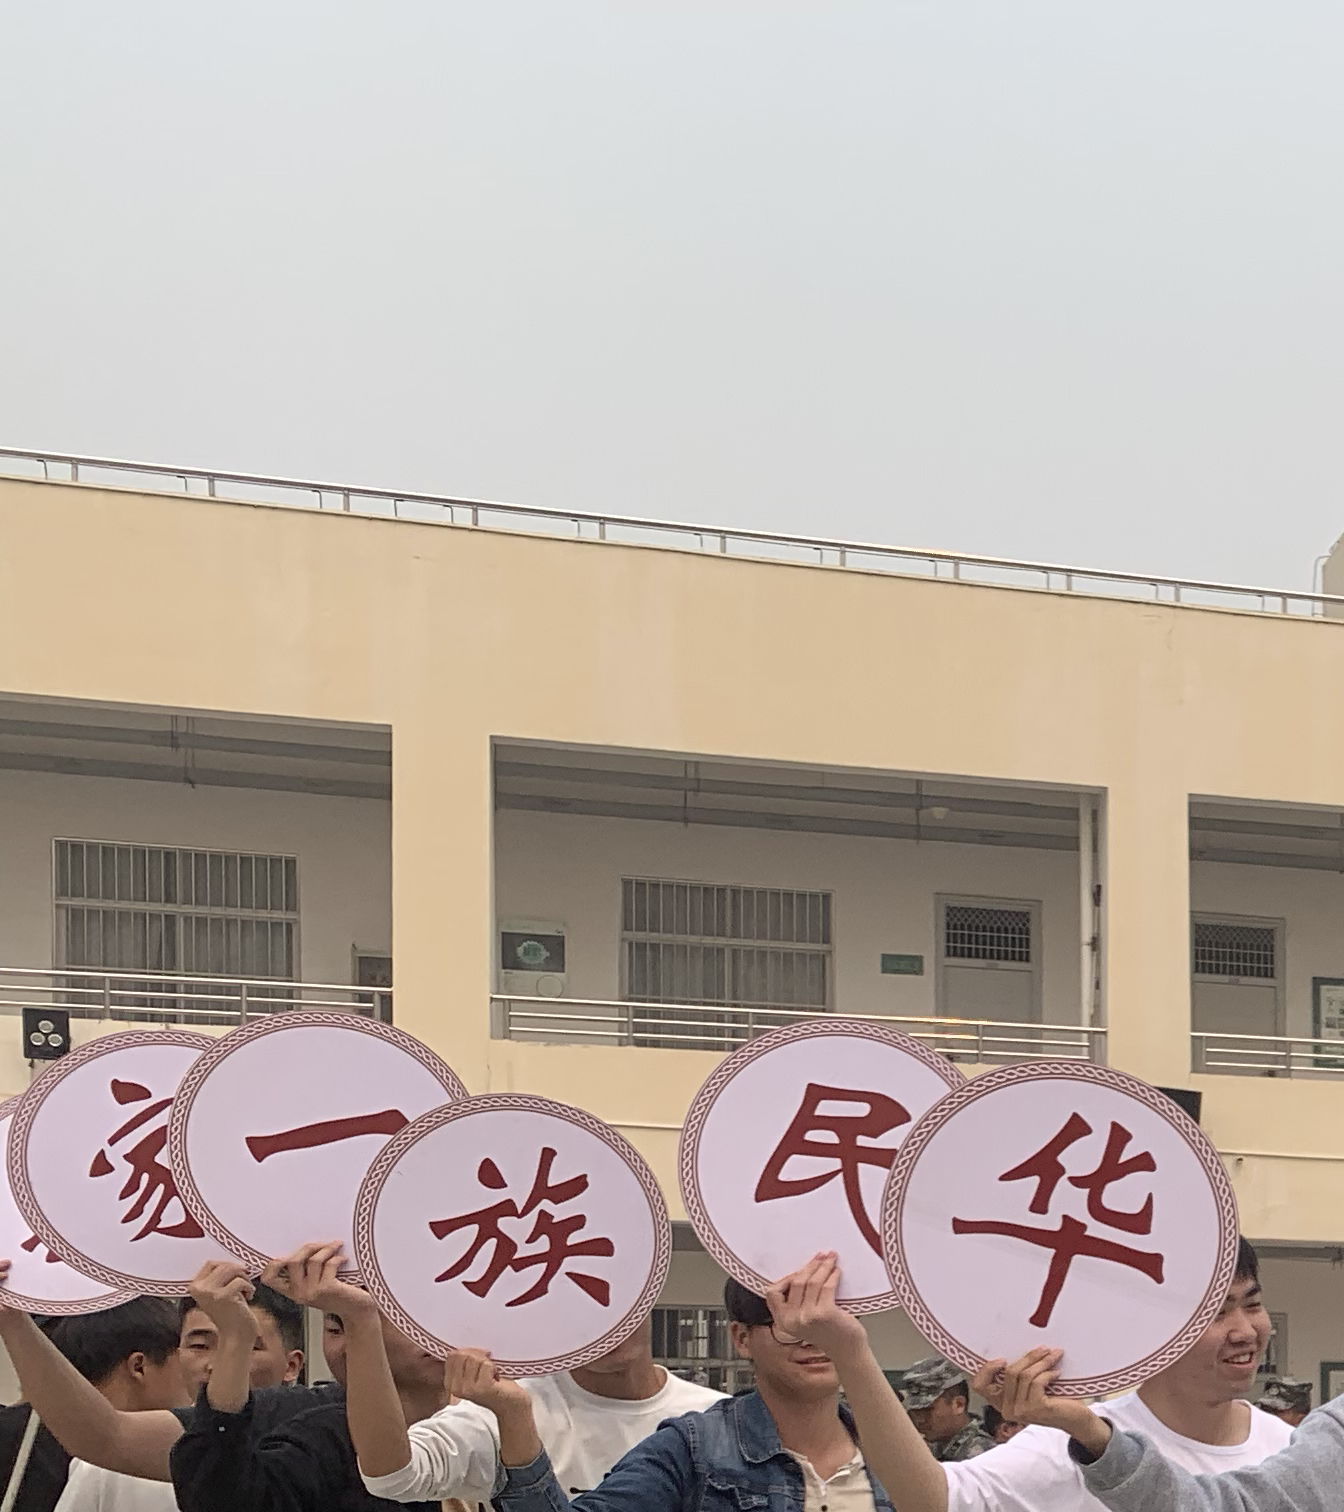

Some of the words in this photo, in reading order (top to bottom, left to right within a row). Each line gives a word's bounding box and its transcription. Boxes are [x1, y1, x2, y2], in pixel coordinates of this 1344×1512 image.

[245, 1108, 410, 1163] 一
[754, 1082, 912, 1257] 民
[429, 1146, 616, 1308] 族
[952, 1112, 1165, 1328] 华
